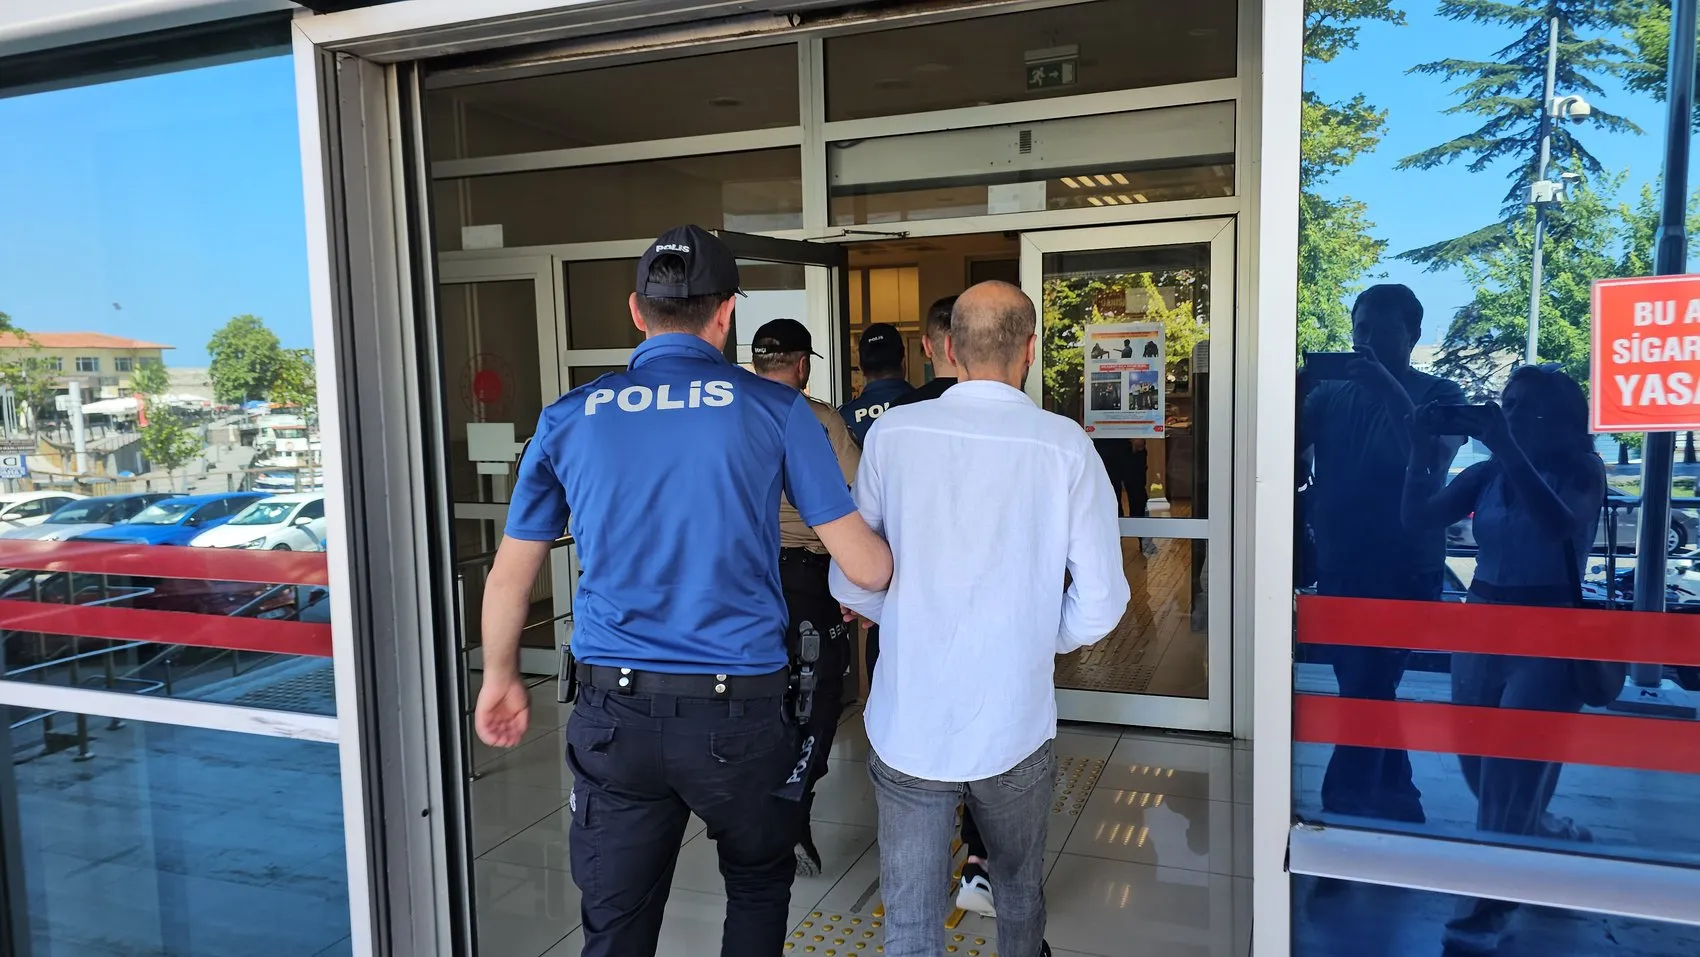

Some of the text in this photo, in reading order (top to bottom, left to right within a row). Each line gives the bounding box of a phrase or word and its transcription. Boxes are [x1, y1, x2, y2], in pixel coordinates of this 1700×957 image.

[1634, 301, 1677, 326] BU
[1612, 333, 1700, 364] SİGAR
[585, 380, 735, 416] POLİS
